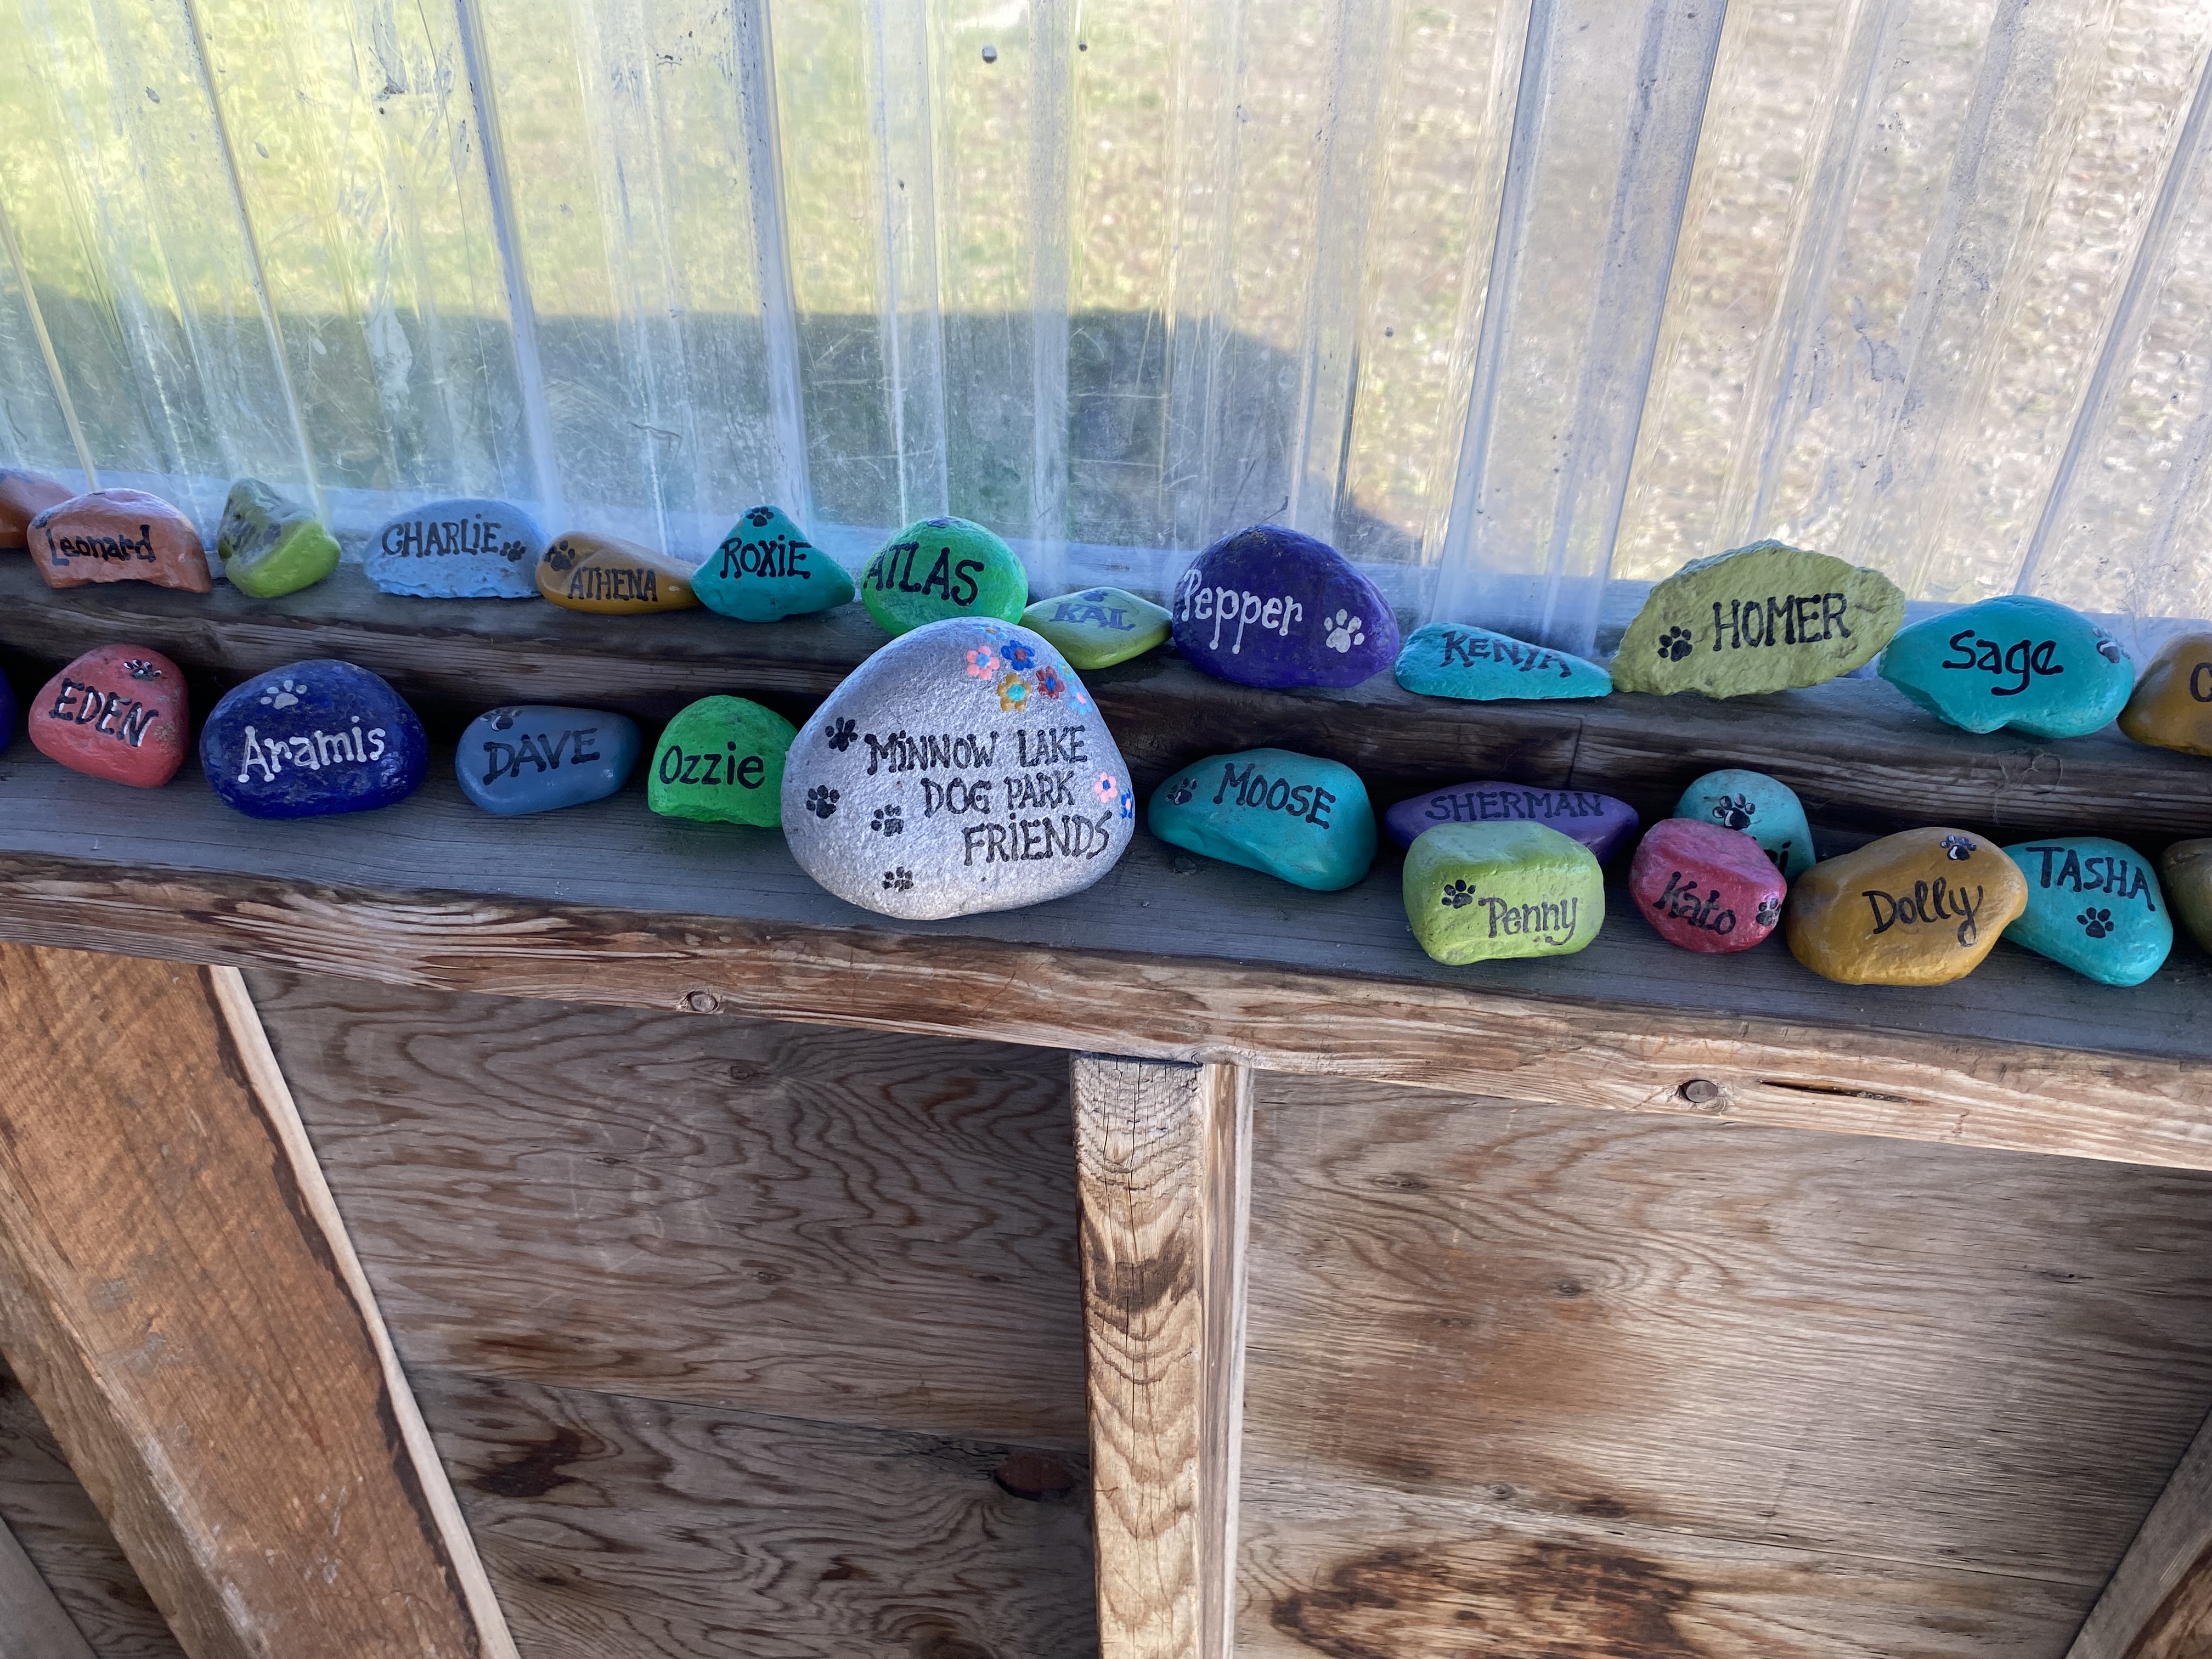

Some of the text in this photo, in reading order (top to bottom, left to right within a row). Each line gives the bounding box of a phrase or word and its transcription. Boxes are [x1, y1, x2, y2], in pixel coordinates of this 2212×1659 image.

[46, 524, 156, 566] Leonard
[863, 541, 985, 607] ATLAS
[567, 567, 659, 603] ATHENA
[1181, 569, 1303, 654] Pepper
[1713, 592, 1849, 652] HOMER
[1942, 629, 2063, 696] Sage
[49, 678, 159, 747] EDEN
[238, 715, 386, 783] Aramis
[483, 727, 601, 786] DAVE
[658, 742, 766, 789] Ozzie
[1017, 725, 1088, 769] LAKE
[921, 770, 1076, 818] DOG PARK
[1214, 763, 1337, 830] MOOSE
[1425, 791, 1605, 821] SHERMAN
[1652, 871, 1737, 935] Kato
[2025, 846, 2156, 912] TASHA
[1479, 896, 1579, 946] Penny
[1862, 877, 1983, 947] Dolly
